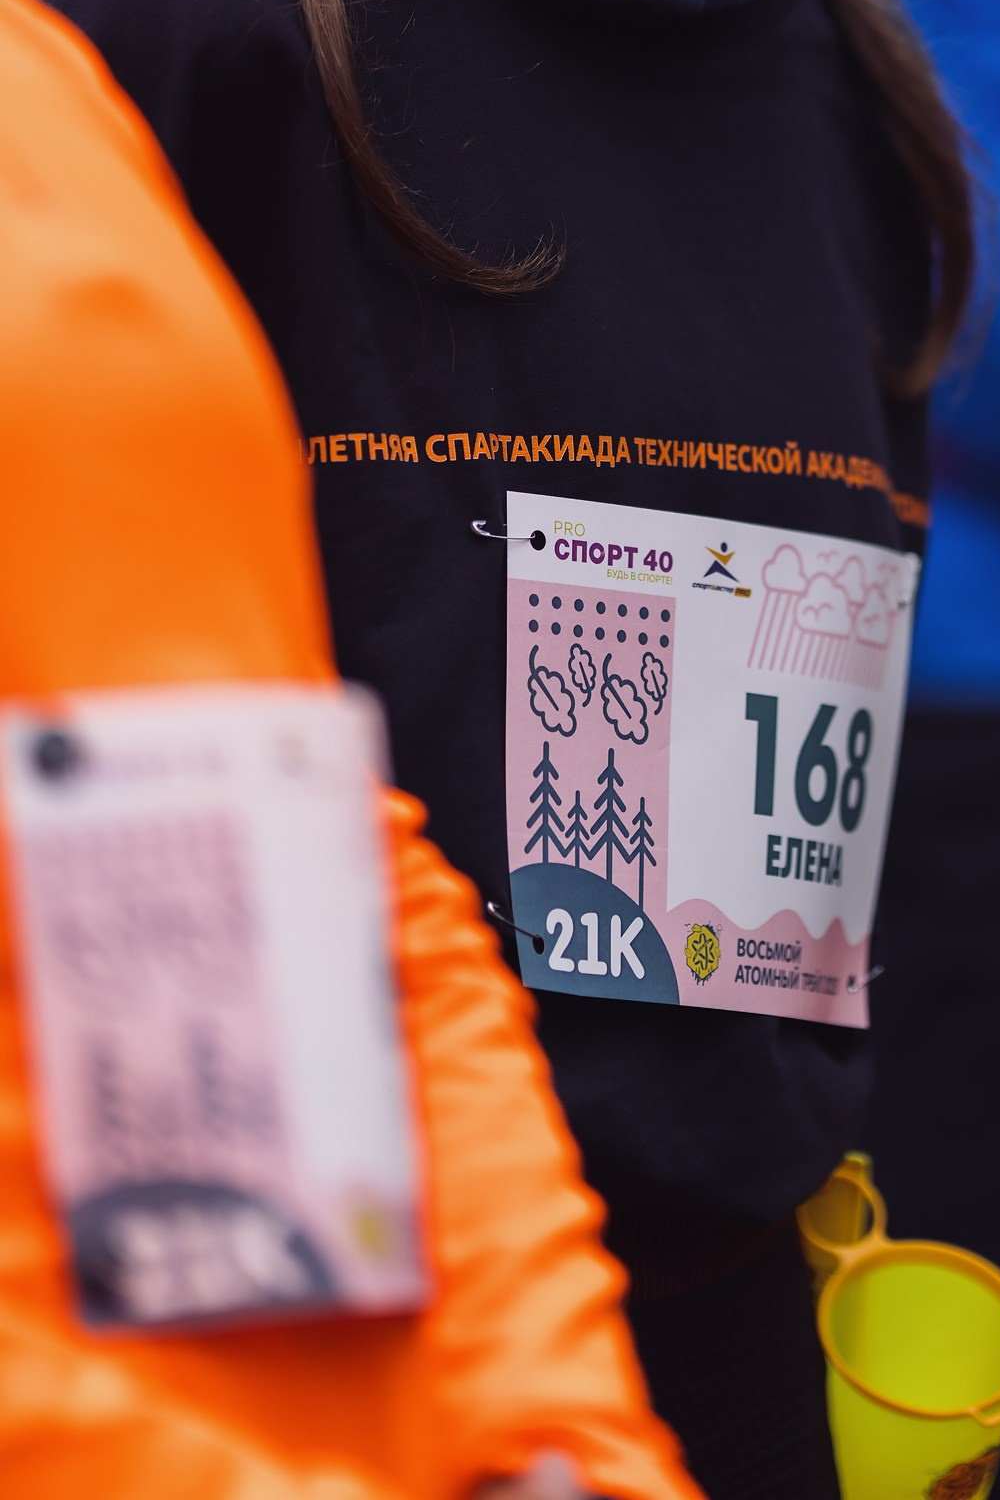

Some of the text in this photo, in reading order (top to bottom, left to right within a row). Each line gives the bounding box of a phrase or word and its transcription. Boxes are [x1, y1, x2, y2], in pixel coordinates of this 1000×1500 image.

[307, 433, 419, 465] ЛЕТНЯЯ
[425, 432, 632, 468] СПАРТАКИАДА
[633, 437, 802, 476] ТЕХНИЧЕСКОЙ
[553, 520, 586, 537] PRO
[554, 538, 674, 573] СПОРТ 40
[744, 692, 873, 834] 168
[765, 834, 843, 888] ЕЛЕНА
[737, 938, 802, 964] ВОСЬМОЙ
[734, 964, 800, 991] АТОМНЫЙ
